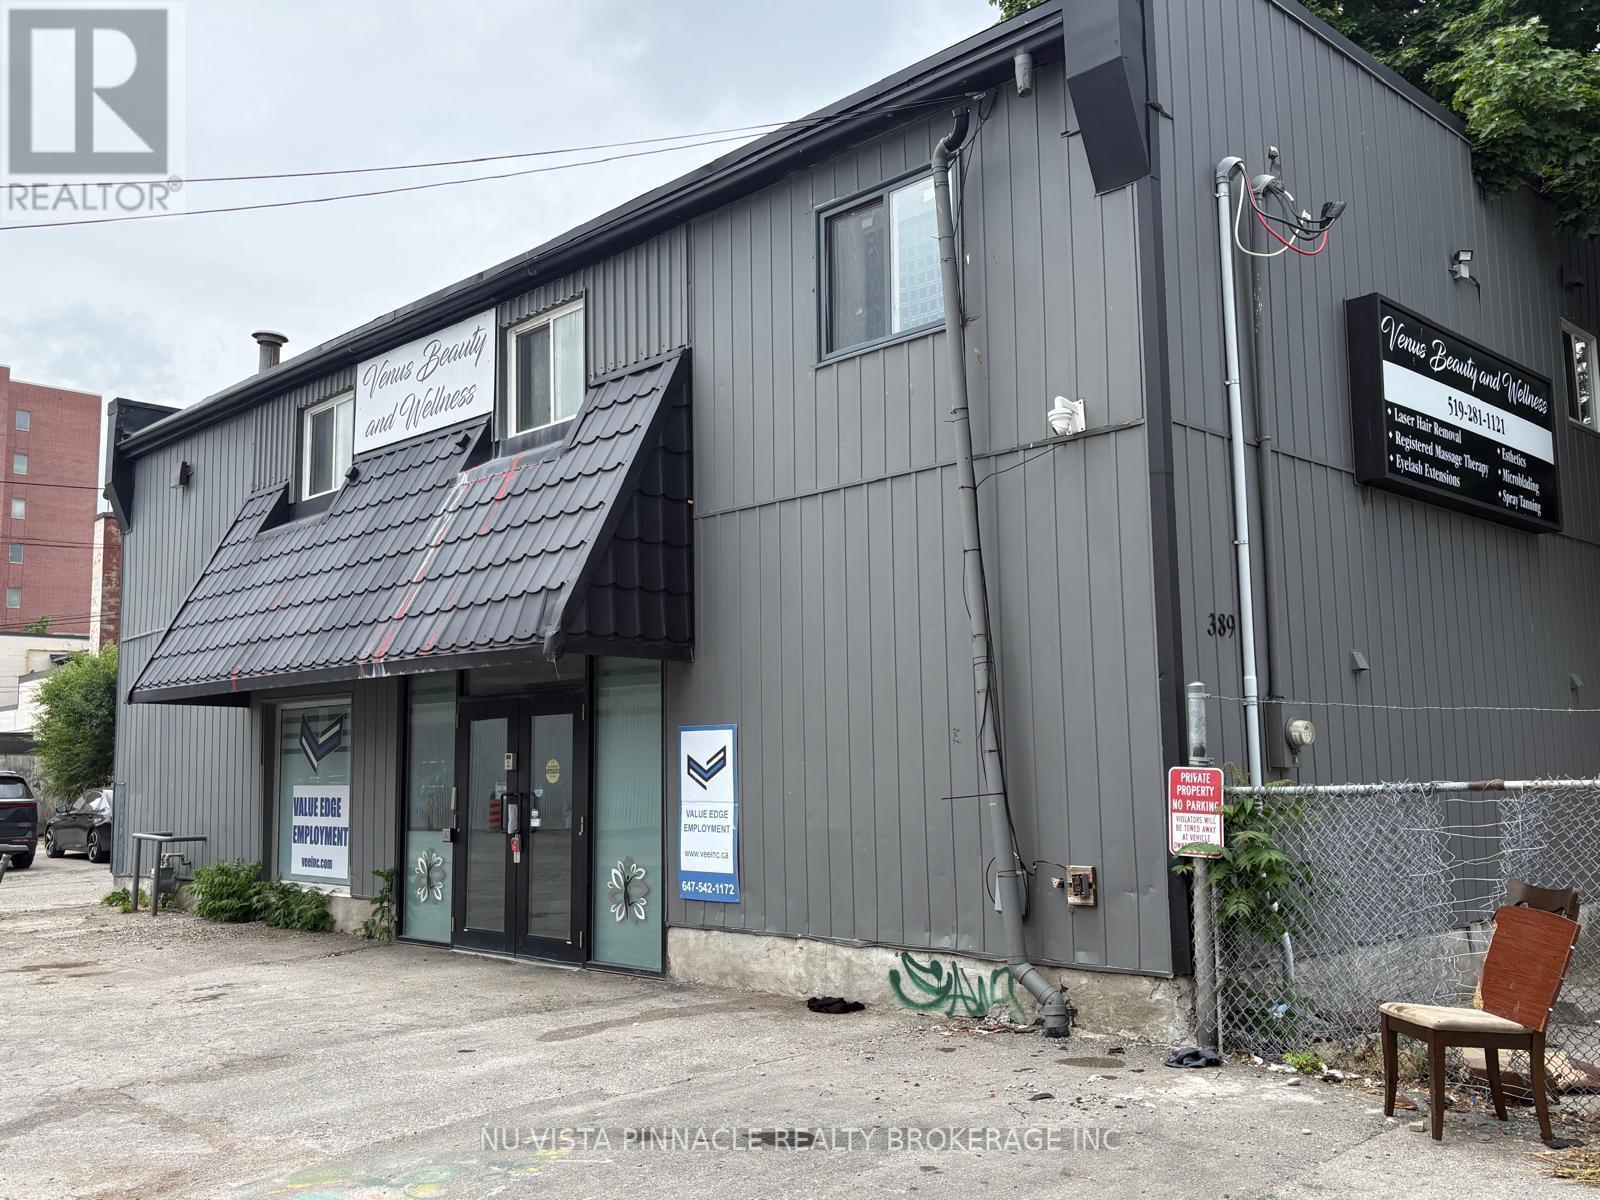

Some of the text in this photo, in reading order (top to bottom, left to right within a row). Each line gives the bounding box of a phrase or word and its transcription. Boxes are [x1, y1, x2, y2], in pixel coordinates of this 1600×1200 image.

[363, 325, 487, 399] Venus Beauty
[1381, 315, 1549, 415] Venus Beauty and Wellness
[365, 384, 477, 438] and Wellness
[1448, 396, 1505, 435] 519-281-1121
[1394, 408, 1462, 444] Laser Hair Removal
[1395, 431, 1489, 478] Registered Massage Therapy
[1501, 447, 1527, 468] Esthetics
[1396, 453, 1461, 488] Eyelash Extensions
[1502, 468, 1540, 496] Microblading
[1502, 489, 1542, 517] Spray Tanning
[1207, 613, 1235, 639] 389
[1180, 772, 1211, 784] PRIVATE
[1176, 785, 1215, 797] PROPERTY
[293, 796, 342, 818] VALUE EDGE
[686, 809, 729, 819] VALUE EDGE
[1172, 798, 1183, 810] NO
[683, 823, 731, 833] EMPLOYMENT
[1175, 824, 1217, 834] BE TOWED AWAY
[1176, 815, 1216, 825] VIOLATORS WILL
[292, 824, 349, 847] EMPLOYMENT
[1189, 833, 1212, 842] VEHICLE
[301, 856, 333, 870] veeinc.com
[684, 849, 729, 859] www.veeinc.ca
[681, 880, 735, 895] 647-542-1172
